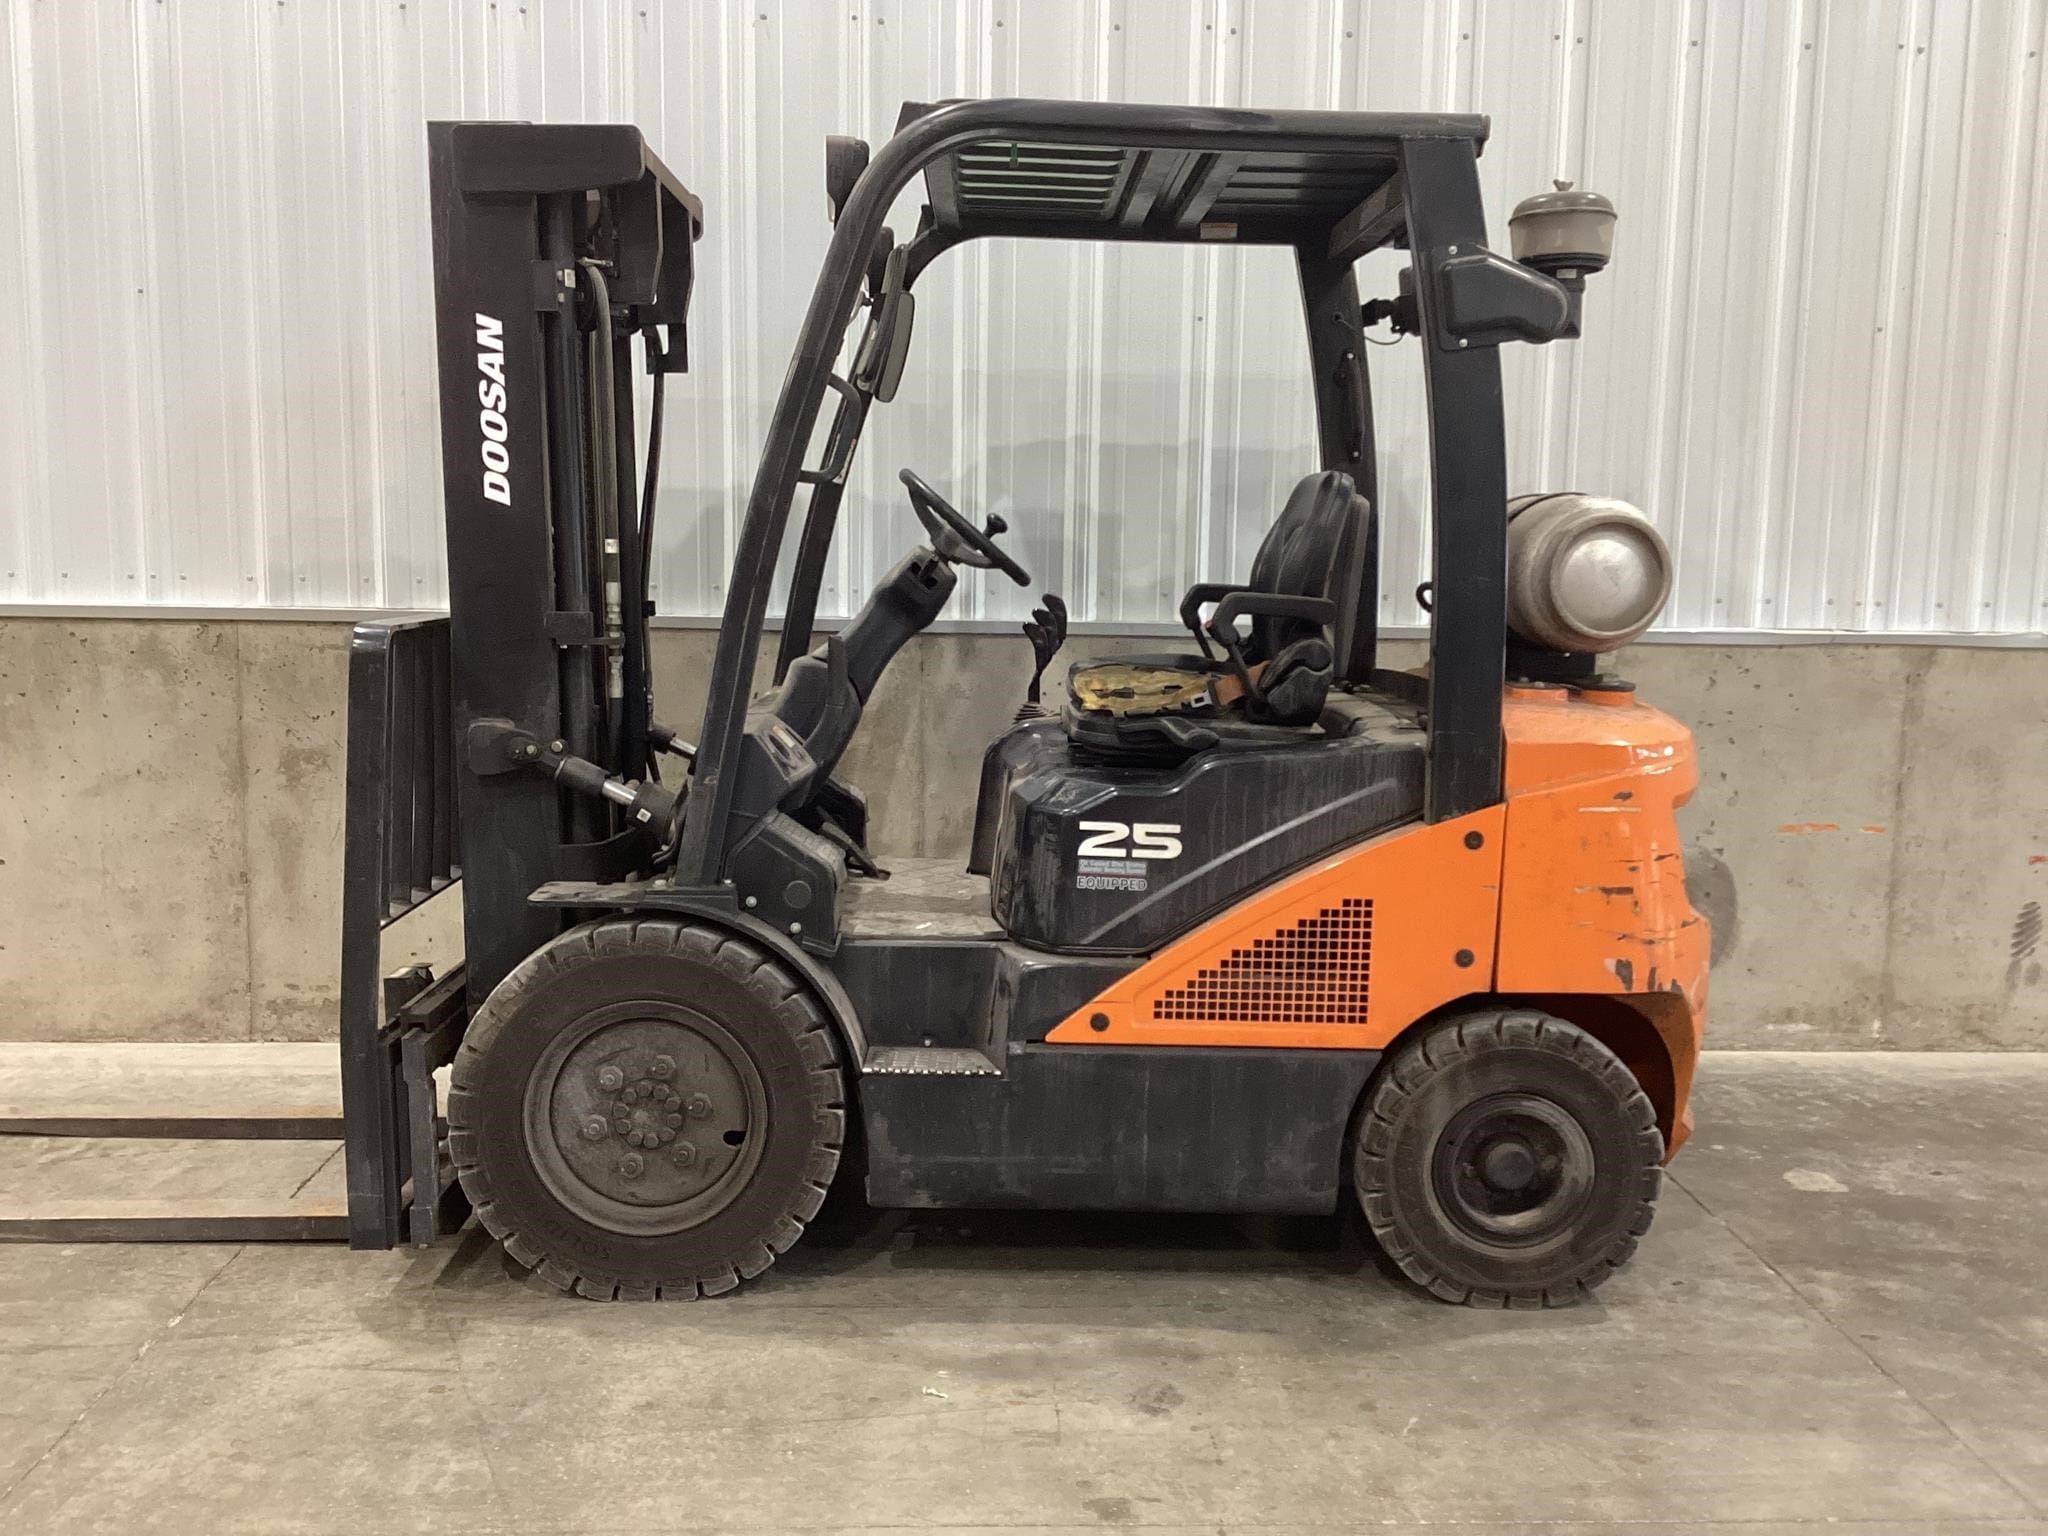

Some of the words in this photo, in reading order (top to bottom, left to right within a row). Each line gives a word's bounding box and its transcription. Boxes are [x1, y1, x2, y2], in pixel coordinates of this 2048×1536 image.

[475, 312, 511, 506] DOOSAN
[1077, 821, 1183, 859] 25
[1076, 876, 1148, 891] EQUIPPED
